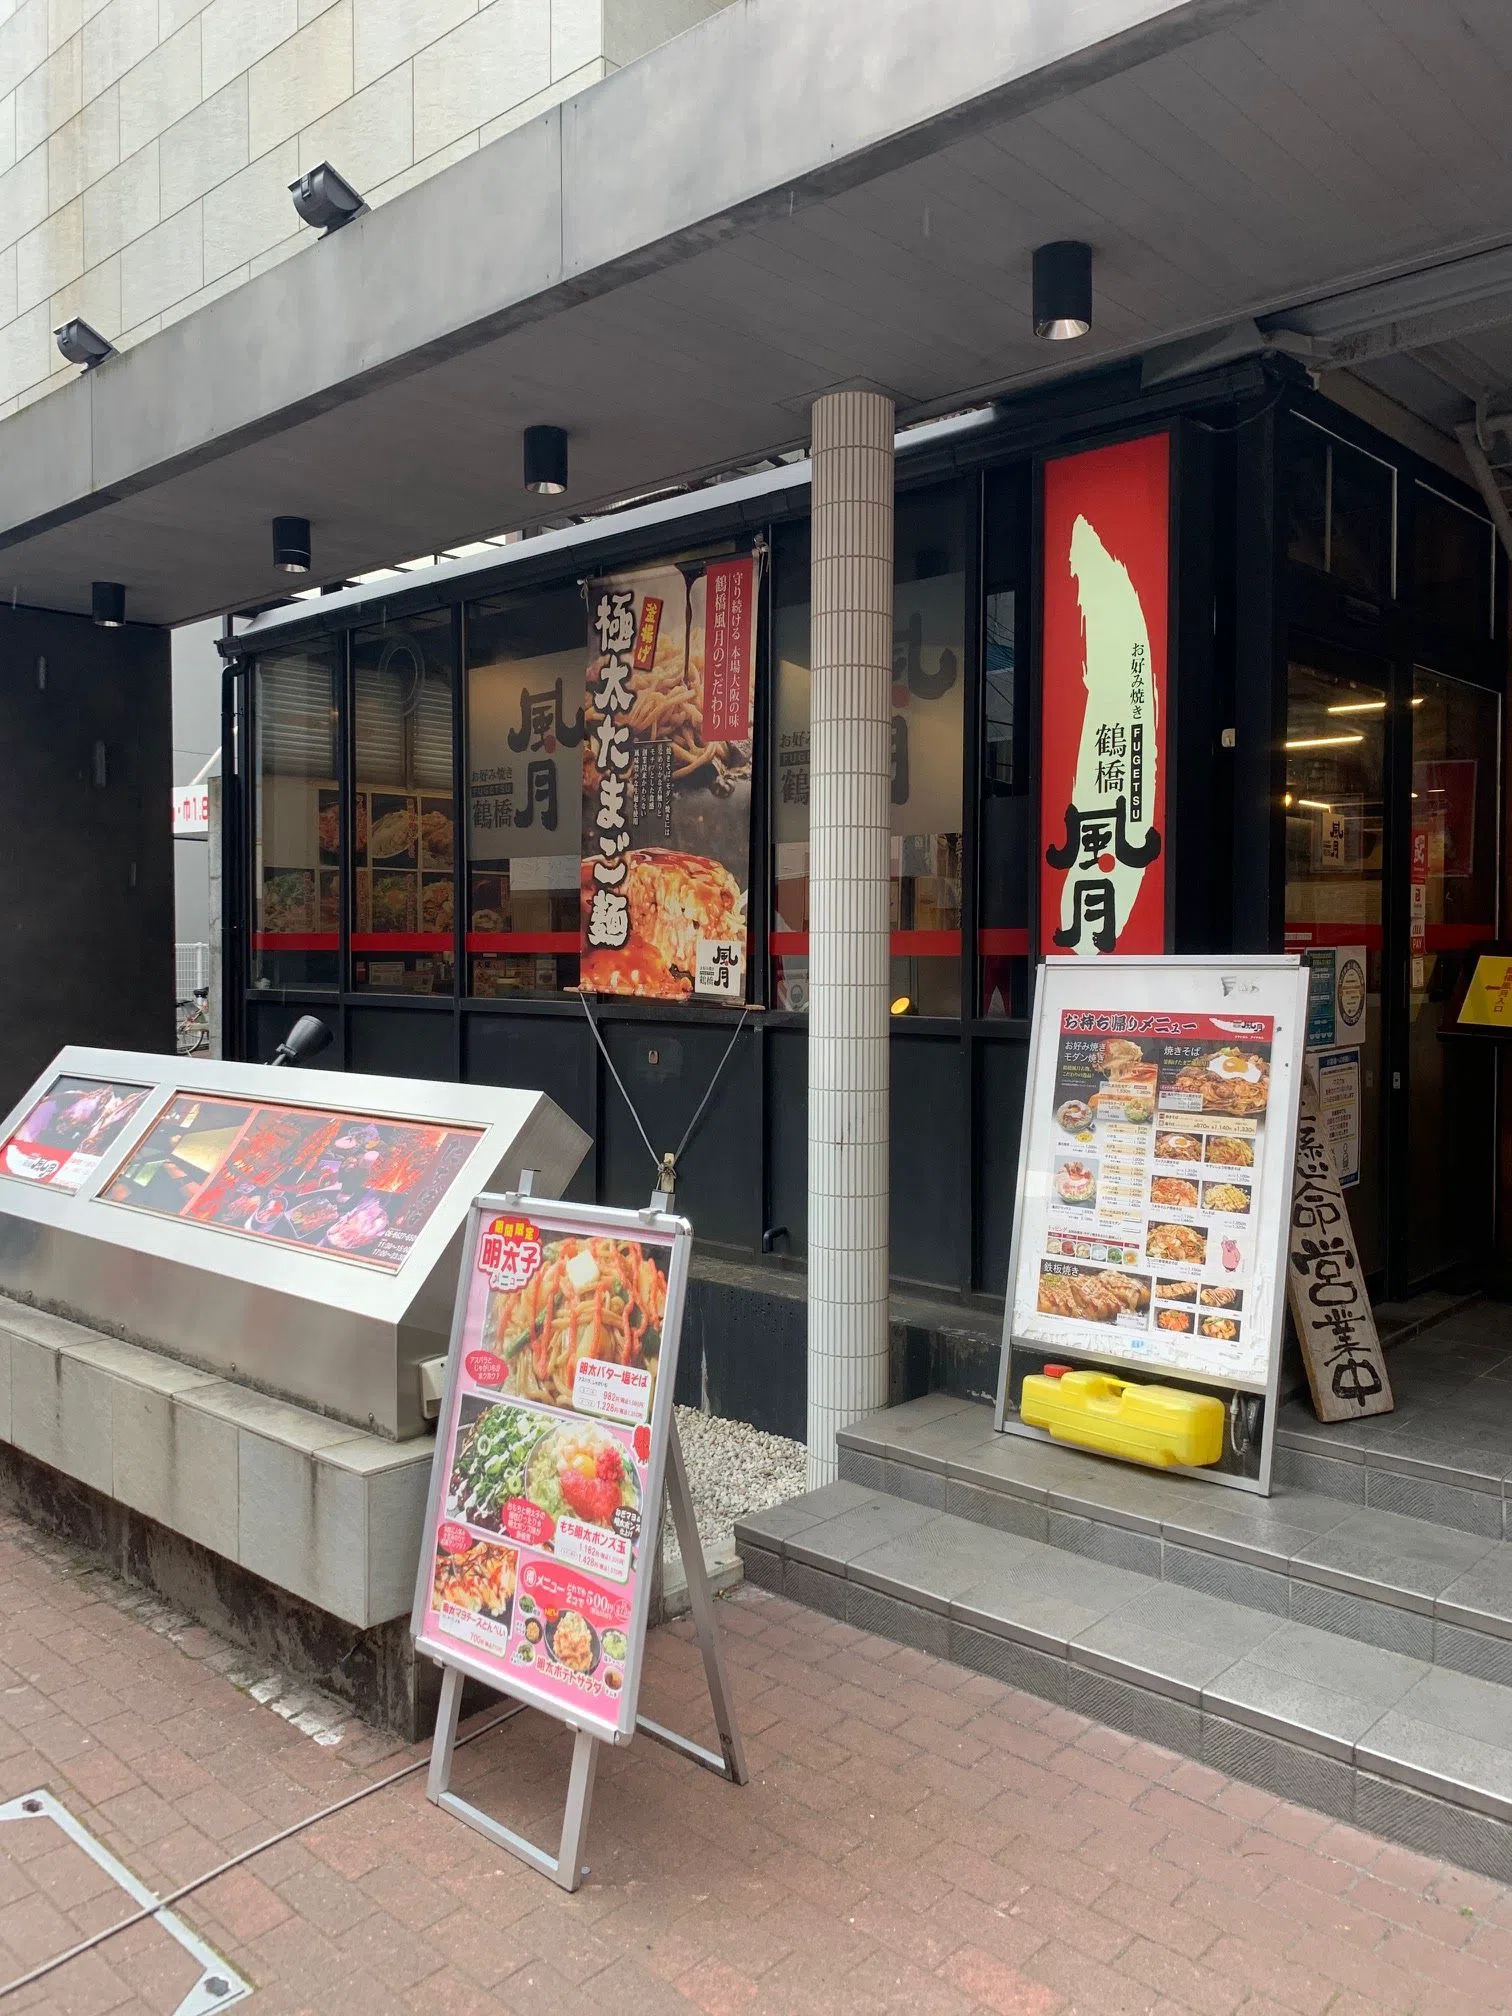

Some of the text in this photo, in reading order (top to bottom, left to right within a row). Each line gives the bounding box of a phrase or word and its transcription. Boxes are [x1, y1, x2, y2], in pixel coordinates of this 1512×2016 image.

[711, 574, 728, 730] 鶴橋風月のこだわり
[727, 571, 744, 729] 守り続ける 本場大阪の味
[1129, 642, 1146, 720] お好み焼き
[507, 676, 585, 831] 風月
[588, 592, 635, 948] 極太たまご麺
[1094, 722, 1127, 794] 鶴橋
[471, 766, 513, 783] お好み焼き
[1131, 727, 1143, 820] FUGETSU
[472, 798, 514, 830] 鶴橋
[1045, 795, 1162, 953] 風月
[712, 944, 739, 989] 風月
[1063, 1013, 1199, 1034] お持ち帰りメニュー
[1064, 1052, 1106, 1064] モダン焼き
[1065, 1041, 1107, 1053] お好み焼き
[1163, 1046, 1201, 1057] 焼きそば
[494, 1220, 536, 1241] 期間限定
[482, 1238, 538, 1274] 明太子
[1043, 1261, 1080, 1278] 鉄板焼き
[492, 1274, 525, 1286] メニュー
[579, 1361, 649, 1388] 明太バター塩そば
[536, 1656, 603, 1694] 明太ポテトサラダ
